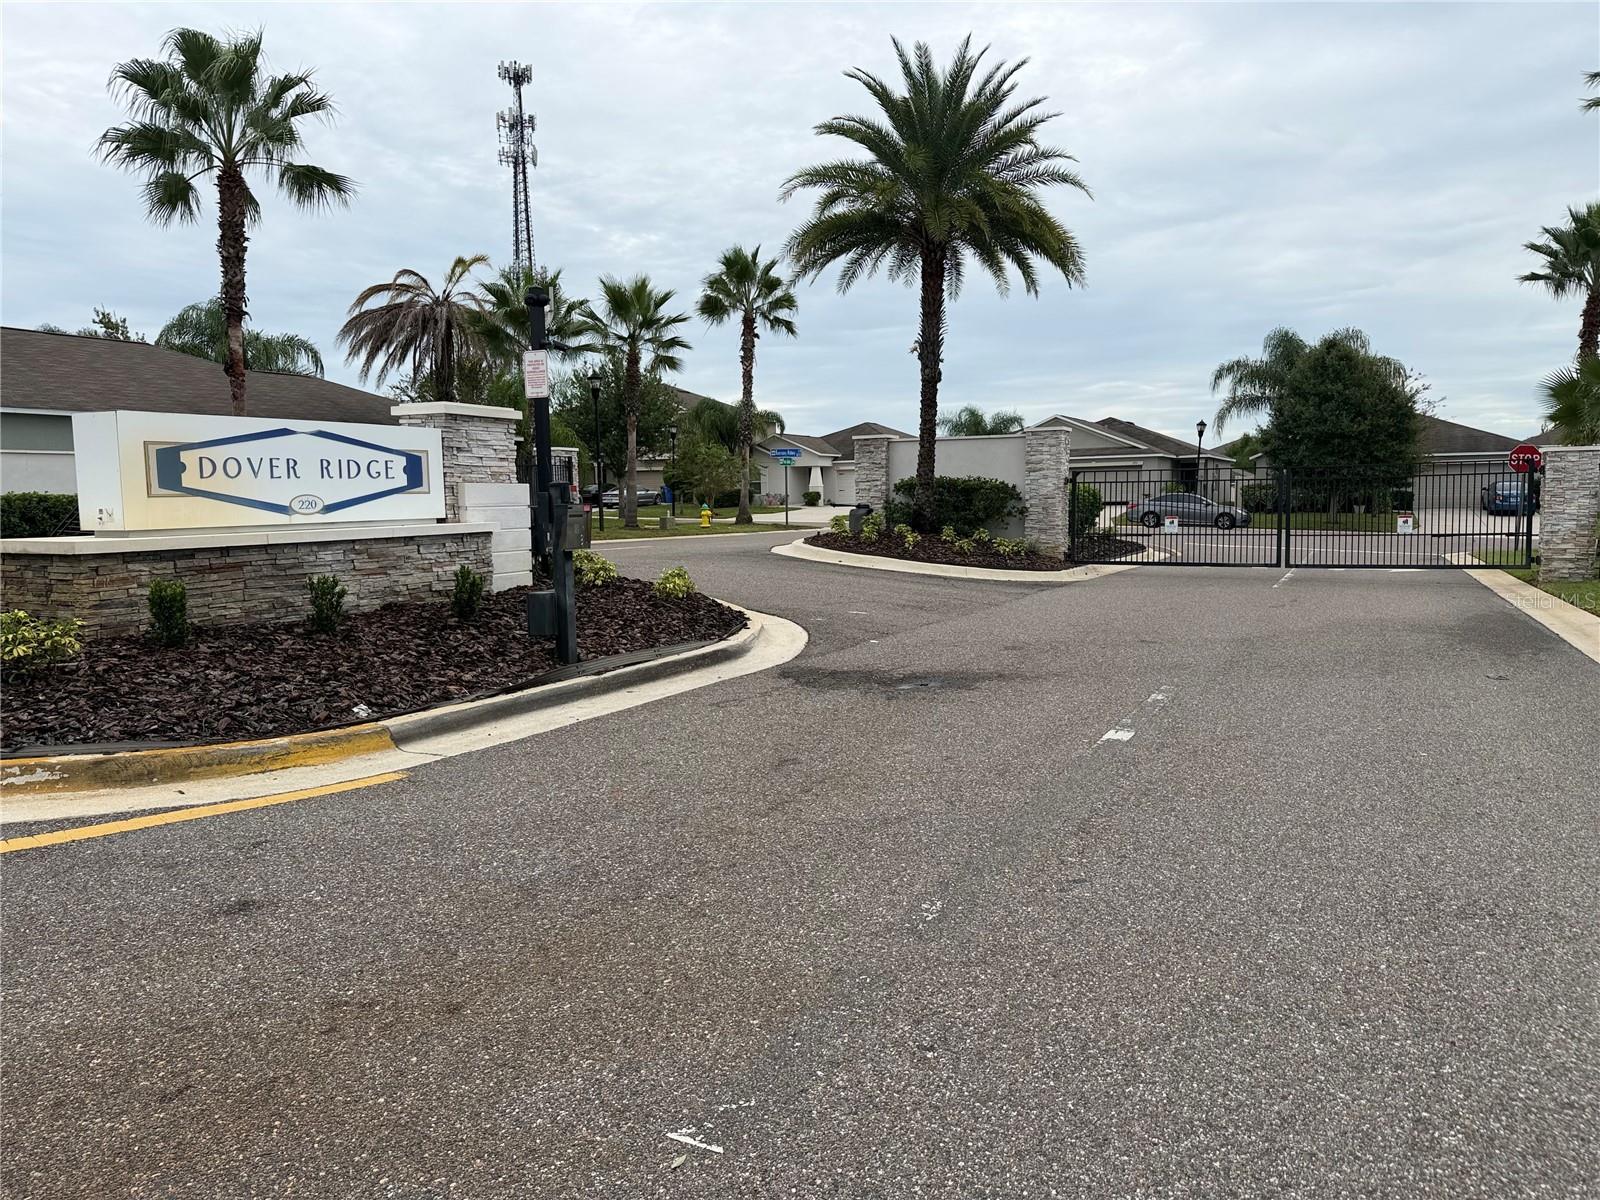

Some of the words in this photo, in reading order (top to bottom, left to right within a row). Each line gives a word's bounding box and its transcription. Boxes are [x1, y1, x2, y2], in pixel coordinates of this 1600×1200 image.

[1510, 453, 1541, 465] STOP
[198, 456, 301, 480] DOVER
[320, 458, 396, 480] RIDGE
[298, 499, 317, 510] 220
